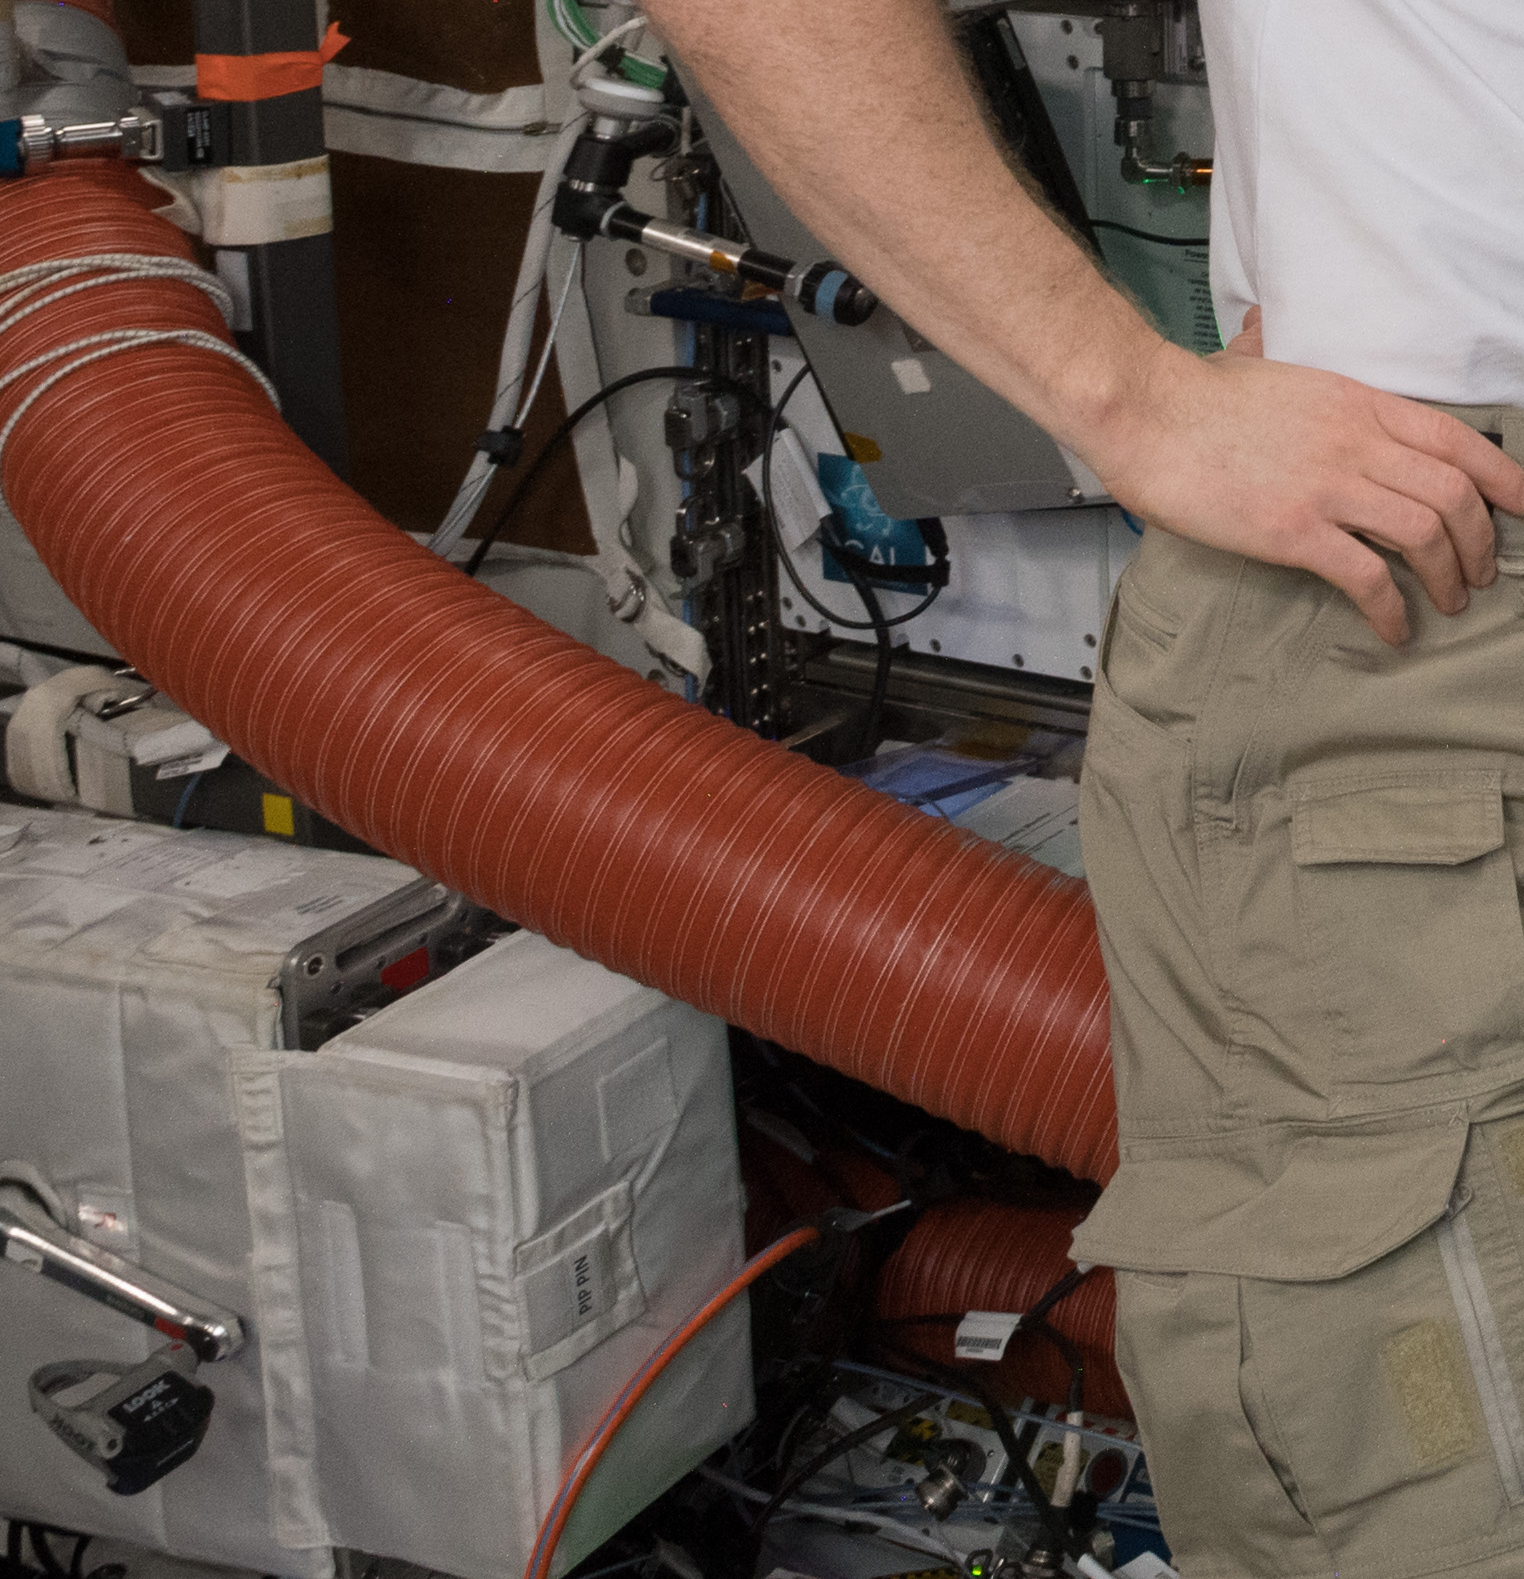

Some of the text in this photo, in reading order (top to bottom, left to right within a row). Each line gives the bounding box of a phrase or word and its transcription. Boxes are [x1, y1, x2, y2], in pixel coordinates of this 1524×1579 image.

[574, 1254, 592, 1316] PIP PIN
[123, 1379, 172, 1414] LOOK
